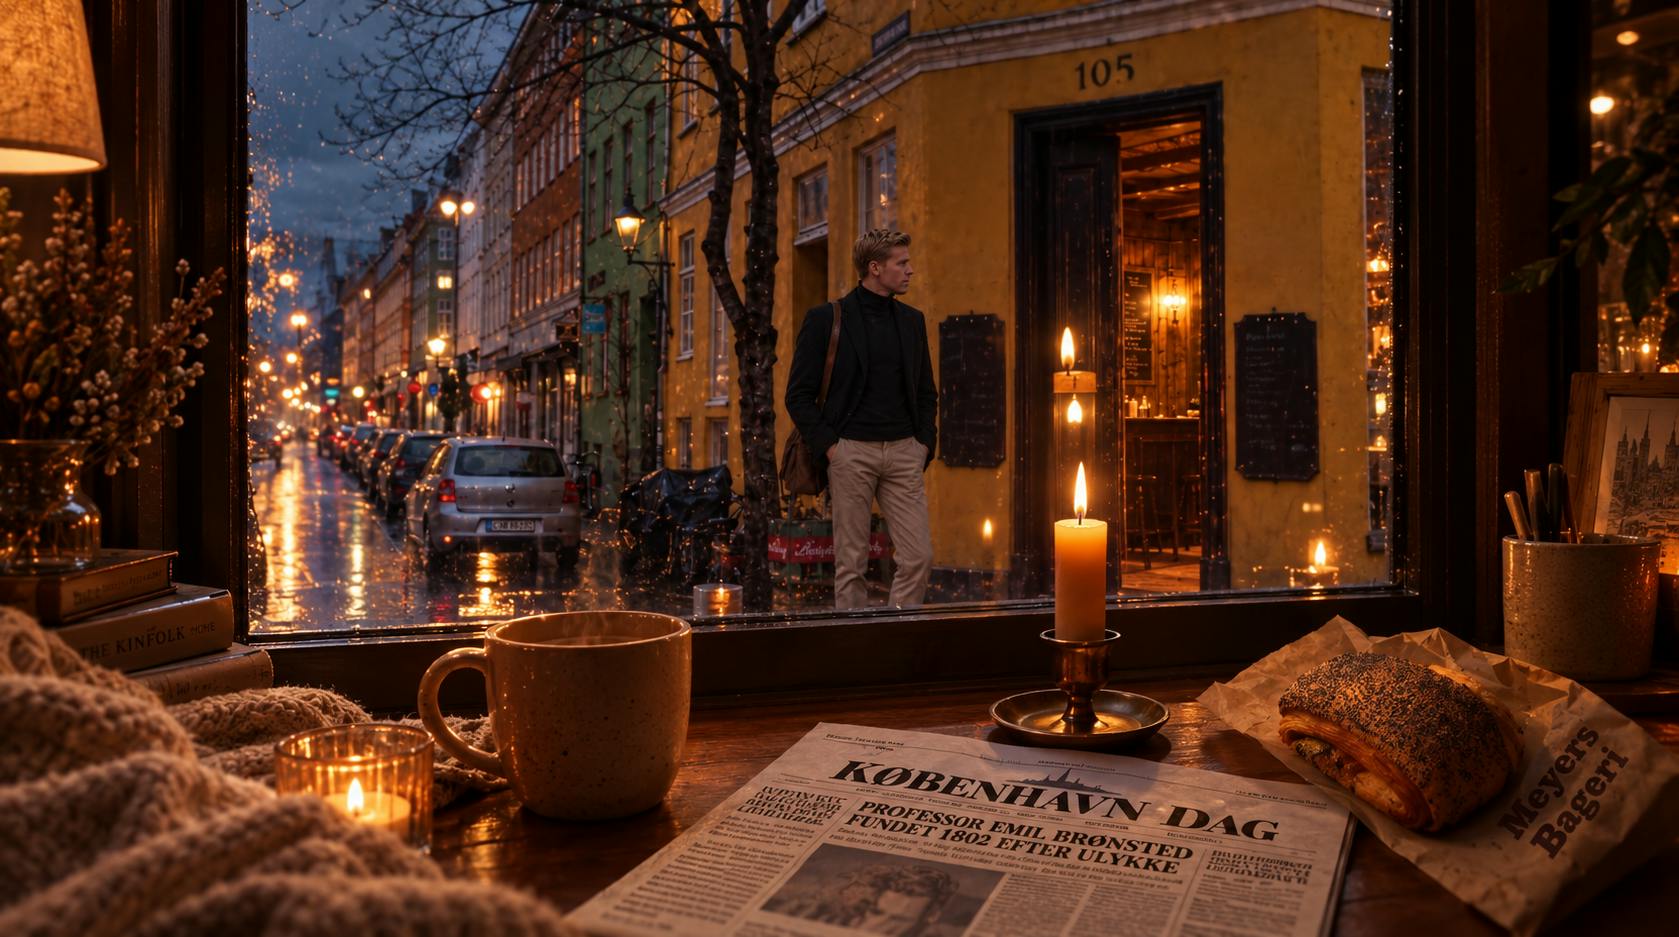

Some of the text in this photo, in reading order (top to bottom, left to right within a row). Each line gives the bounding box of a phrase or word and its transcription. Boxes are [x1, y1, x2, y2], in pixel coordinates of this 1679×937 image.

[1074, 53, 1135, 91] 105
[80, 642, 111, 661] THE
[116, 625, 185, 654] KINFOLK
[829, 760, 1151, 822] KØBENHAVN
[1160, 804, 1279, 842] DAG
[1497, 726, 1600, 841] Meyers
[1530, 746, 1629, 860] Bageri
[845, 813, 938, 837] FUNDET
[938, 828, 992, 847] 1802
[994, 836, 1072, 860] EFTER
[1076, 848, 1180, 875] ULYKKE
[858, 801, 985, 830] PROFESSOR
[989, 820, 1046, 840] EMIL
[1052, 829, 1193, 860] BRØNSTED
